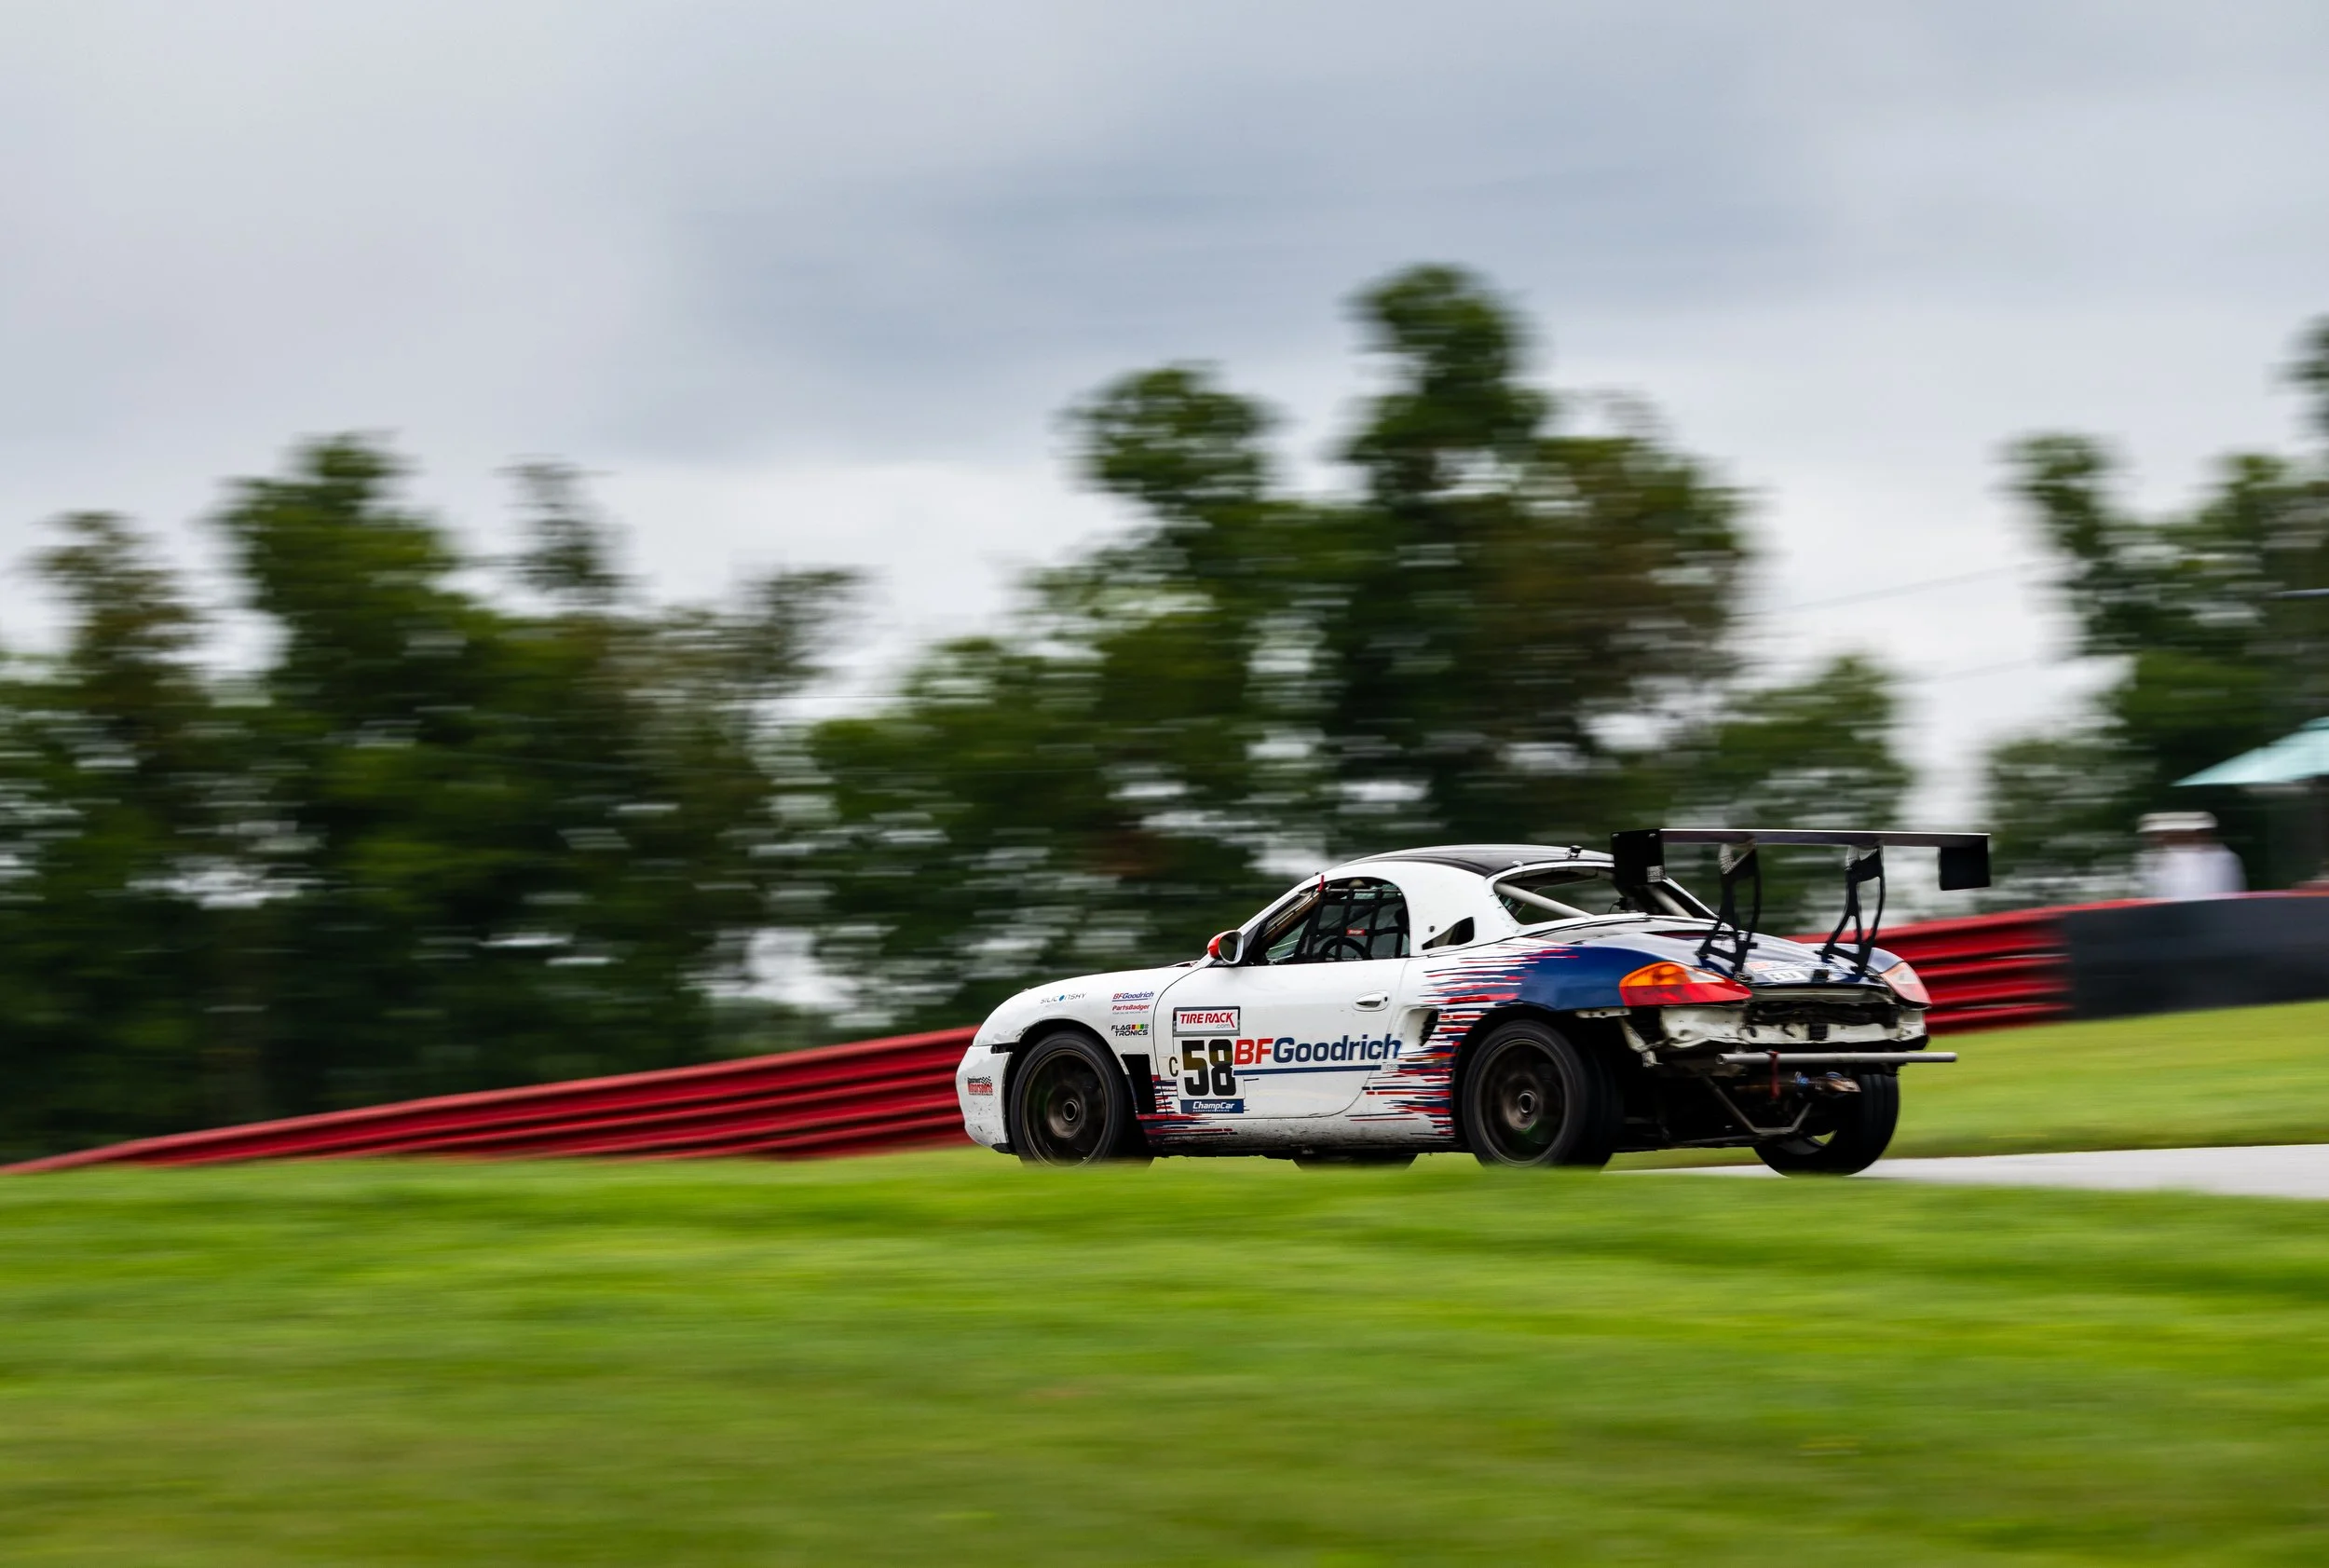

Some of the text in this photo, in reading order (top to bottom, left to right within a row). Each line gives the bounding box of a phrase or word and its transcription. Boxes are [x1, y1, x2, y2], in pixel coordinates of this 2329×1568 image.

[1112, 991, 1154, 1000] BFGoodrich
[1179, 1012, 1235, 1029] TIRE RACK
[1233, 1033, 1402, 1066] BFGoodrich
[1168, 1056, 1178, 1078] C
[1181, 1039, 1237, 1097] 58
[1192, 1100, 1235, 1112] ChampCar
